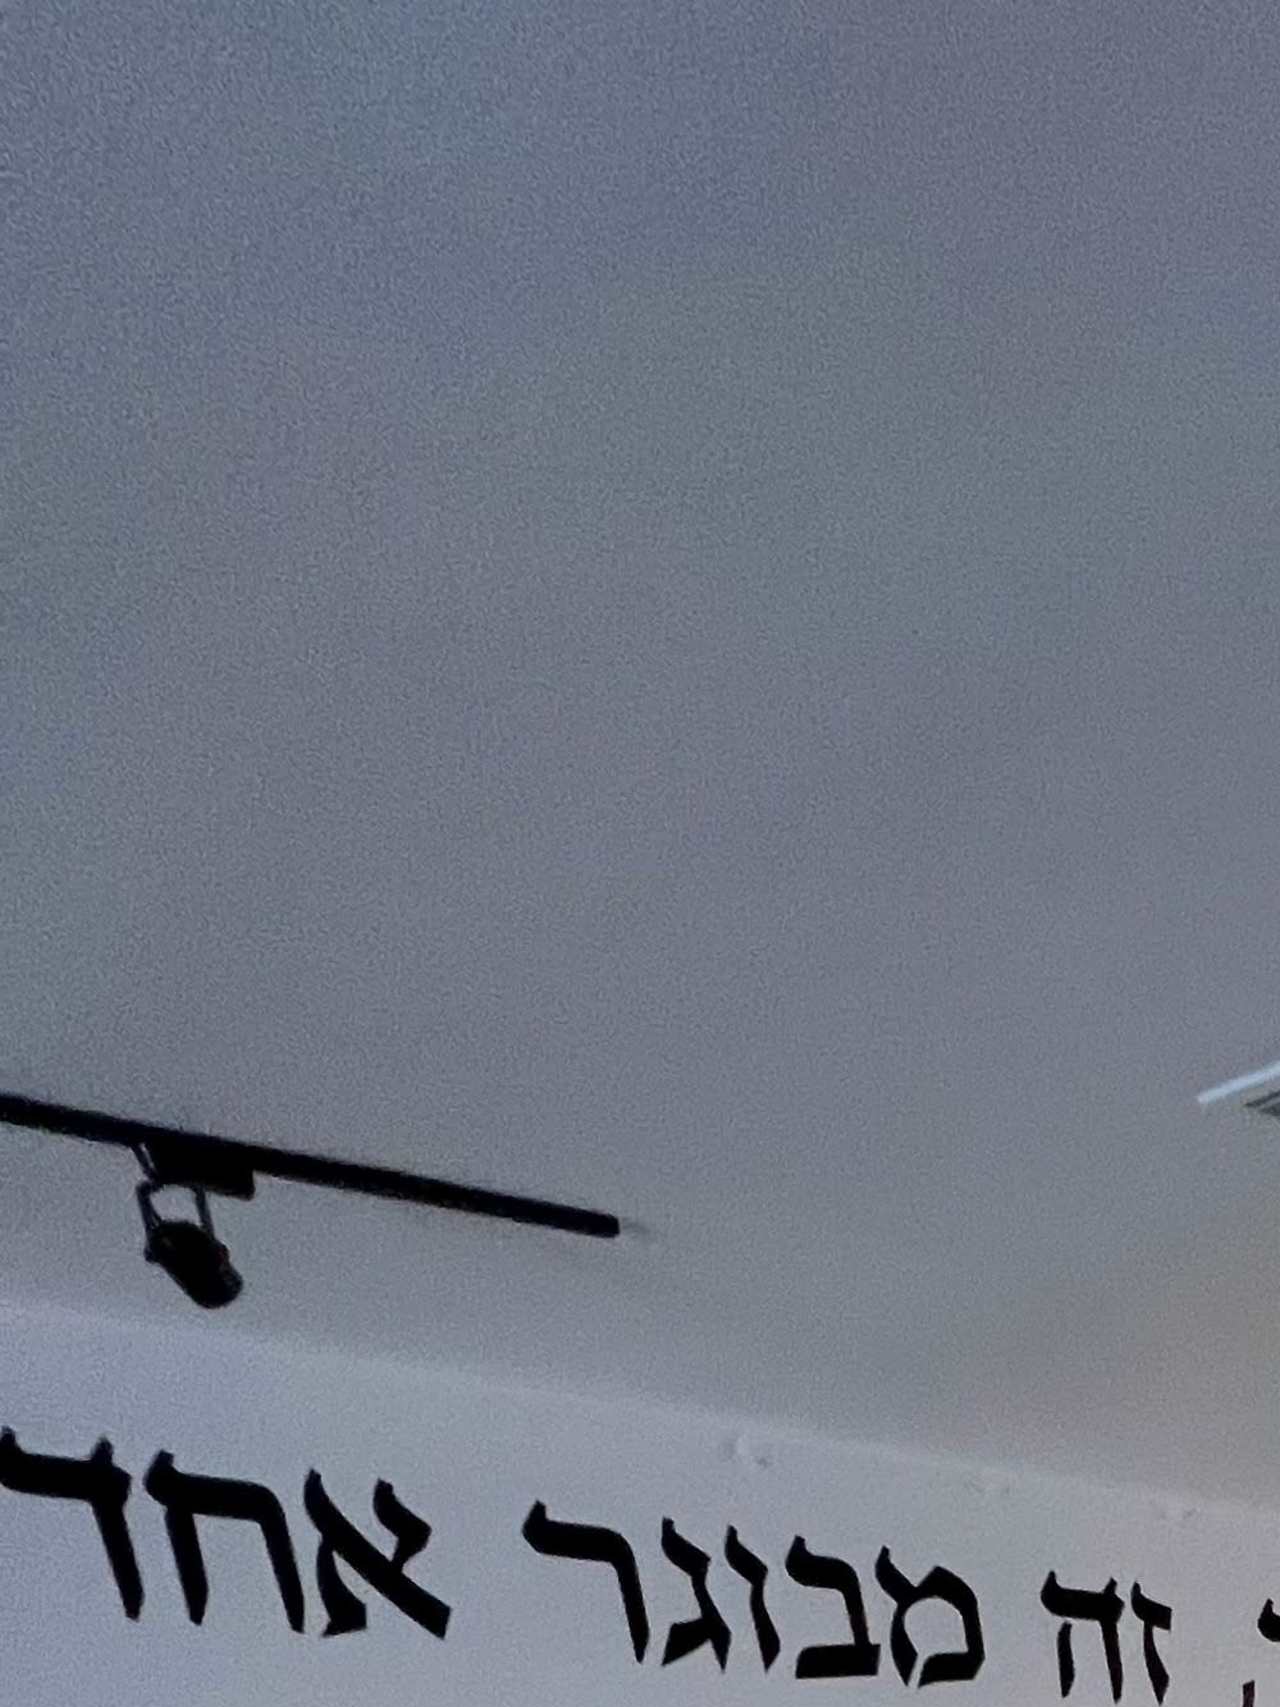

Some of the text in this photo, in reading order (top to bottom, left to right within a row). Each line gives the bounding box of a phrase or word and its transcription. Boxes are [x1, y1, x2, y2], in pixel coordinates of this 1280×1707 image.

[0, 1425, 453, 1641] אחד
[521, 1499, 986, 1689] מבוגר
[1040, 1570, 1172, 1706] זה
